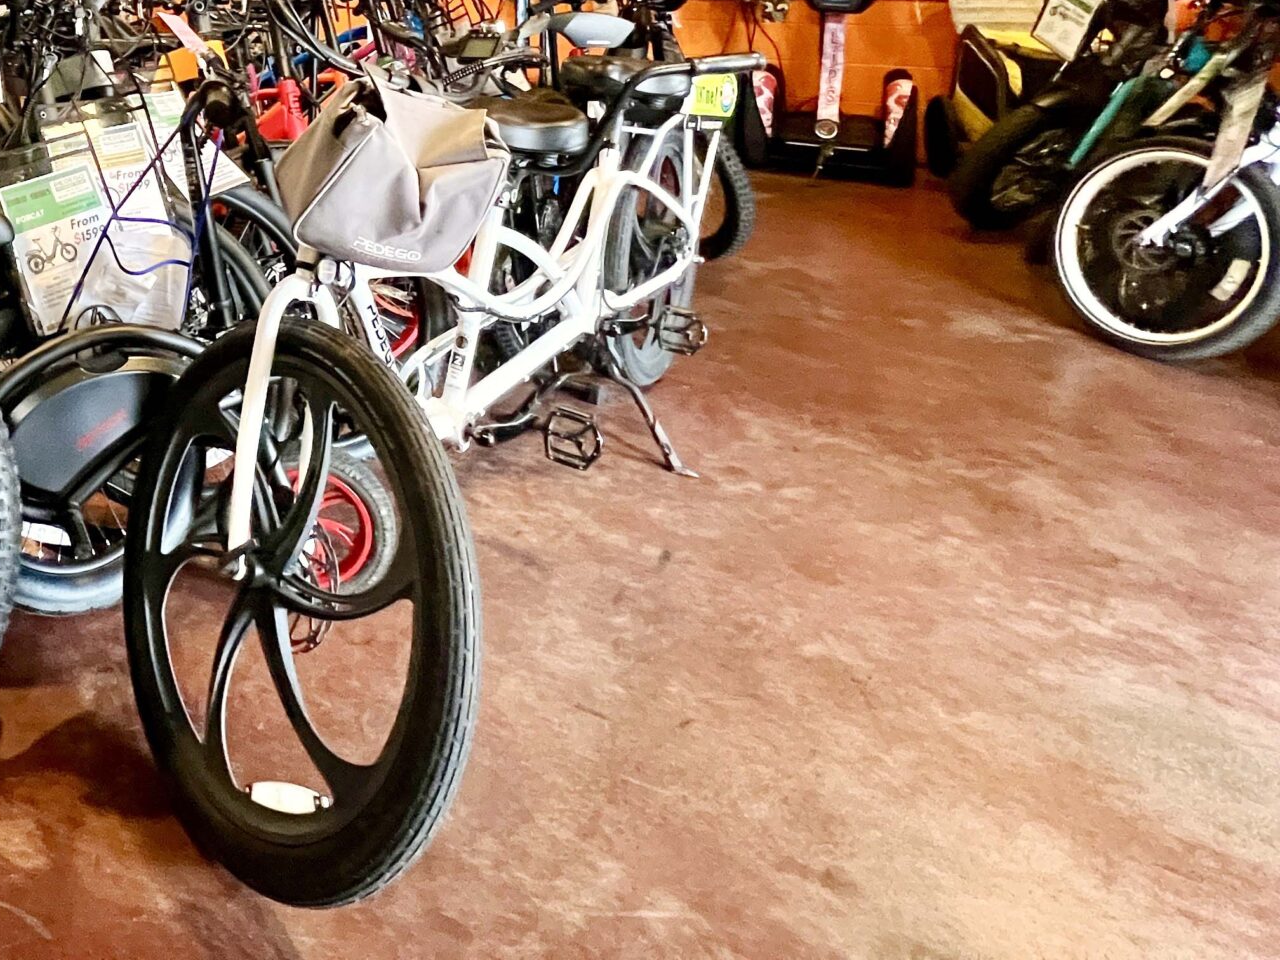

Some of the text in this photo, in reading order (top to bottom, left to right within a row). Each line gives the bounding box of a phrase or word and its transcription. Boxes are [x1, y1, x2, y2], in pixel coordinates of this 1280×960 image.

[70, 214, 100, 230] From
[353, 236, 422, 261] PEDEGO
[367, 304, 396, 369] PEDEG
